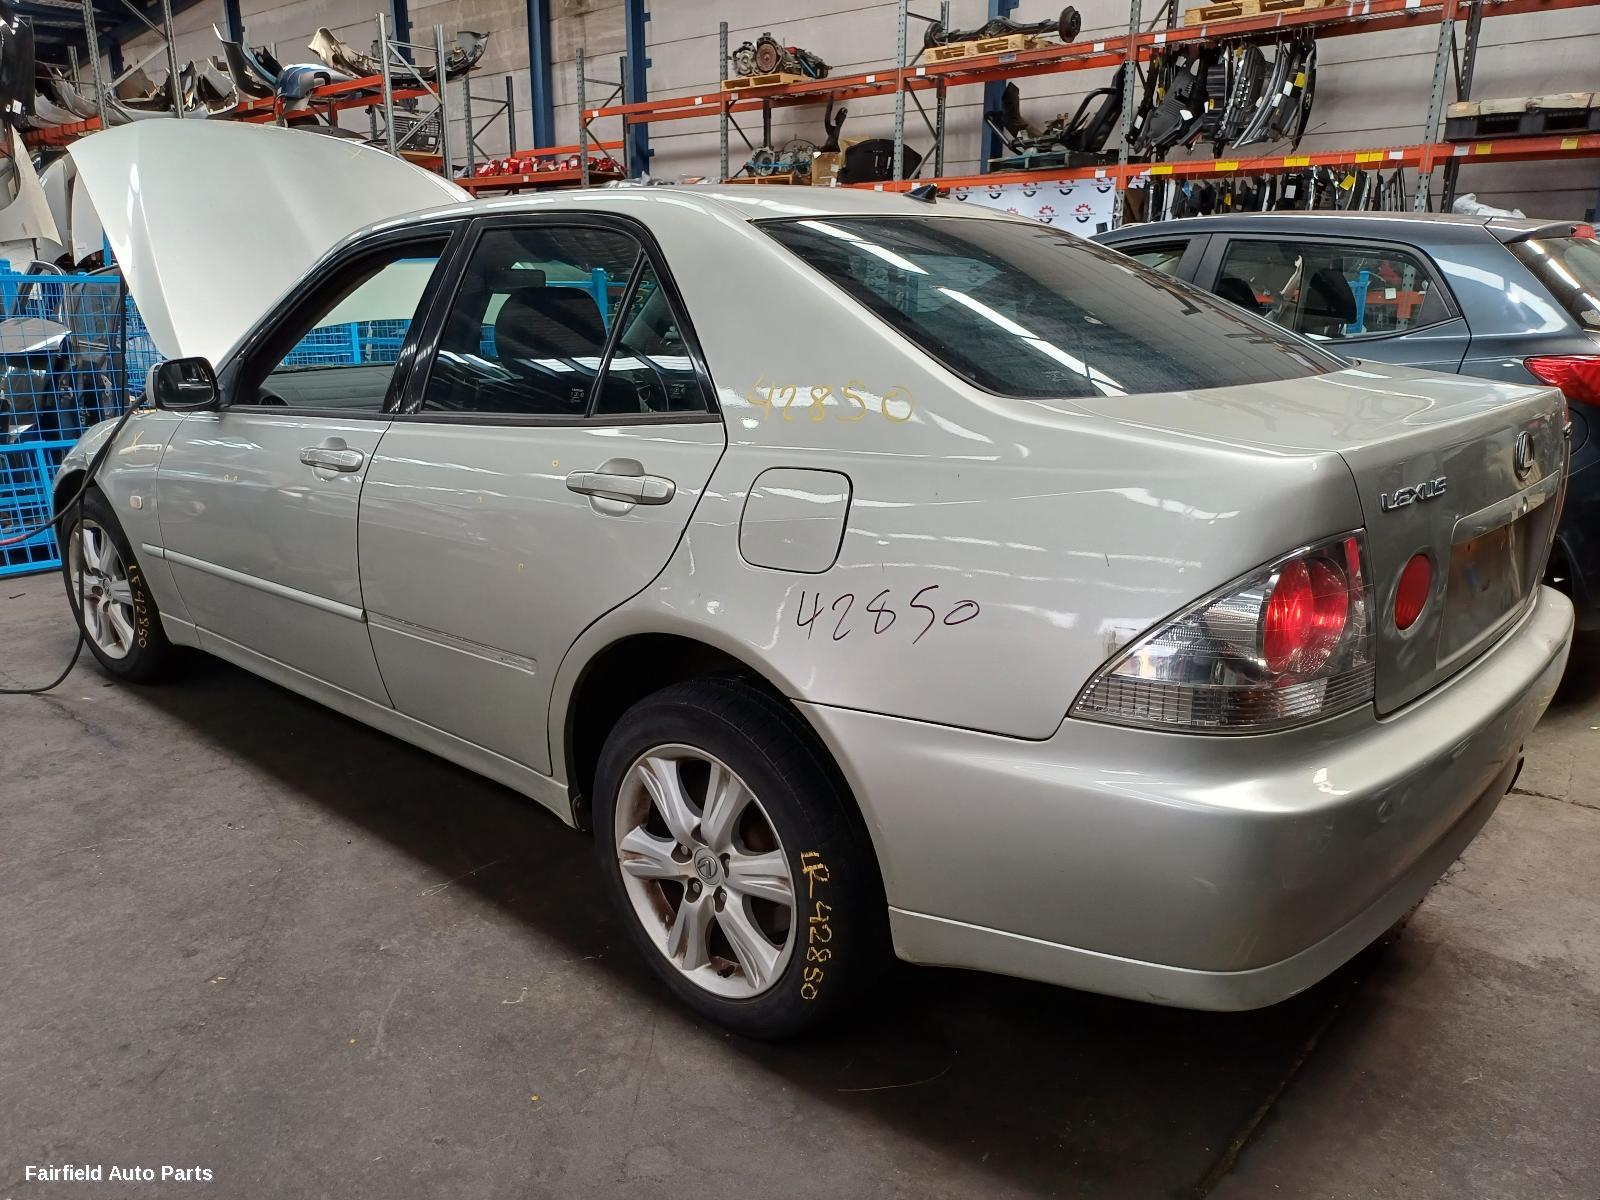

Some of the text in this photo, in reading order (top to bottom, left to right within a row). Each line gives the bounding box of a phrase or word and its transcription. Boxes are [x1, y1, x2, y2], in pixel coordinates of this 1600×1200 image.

[747, 375, 913, 423] 42850
[1380, 476, 1448, 512] LEXUS
[796, 584, 981, 645] 42850
[801, 900, 833, 1000] 42850
